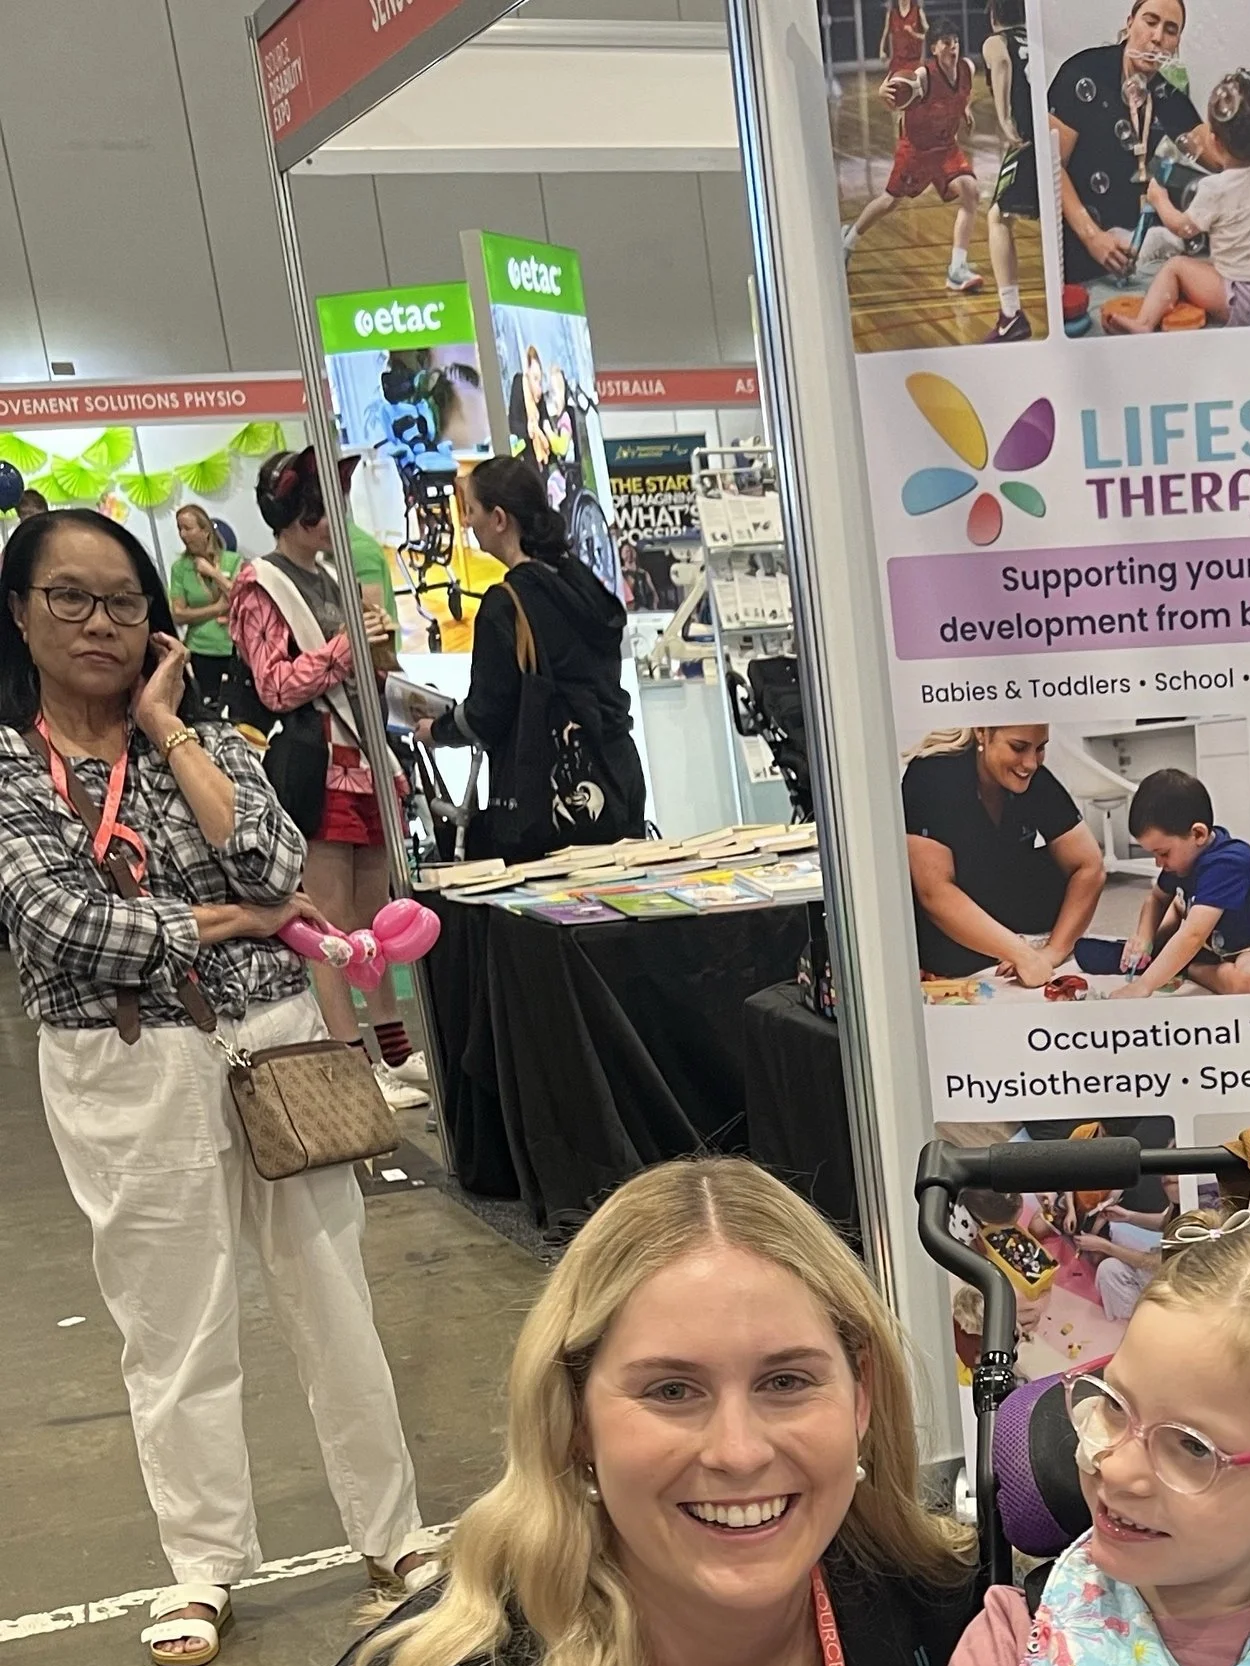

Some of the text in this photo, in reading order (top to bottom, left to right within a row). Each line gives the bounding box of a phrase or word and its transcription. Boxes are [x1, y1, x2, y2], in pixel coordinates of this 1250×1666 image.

[268, 56, 304, 105] DISABILITY
[273, 99, 291, 132] EXPO
[520, 255, 561, 296] etac
[374, 301, 441, 336] etac
[0, 390, 246, 416] OVEMENT SOLUTIONS PHYSIO
[597, 379, 666, 397] USTRALIA
[611, 477, 643, 495] THE
[1001, 557, 1177, 597] Supporting
[939, 605, 1149, 646] development
[1156, 601, 1231, 631] from
[921, 681, 998, 704] Babies
[1005, 680, 1022, 700] &
[1028, 674, 1130, 699] Toddlers
[1155, 668, 1234, 692] School
[1027, 1020, 1241, 1053] Occupational
[946, 1070, 1171, 1103] Physiotherapy
